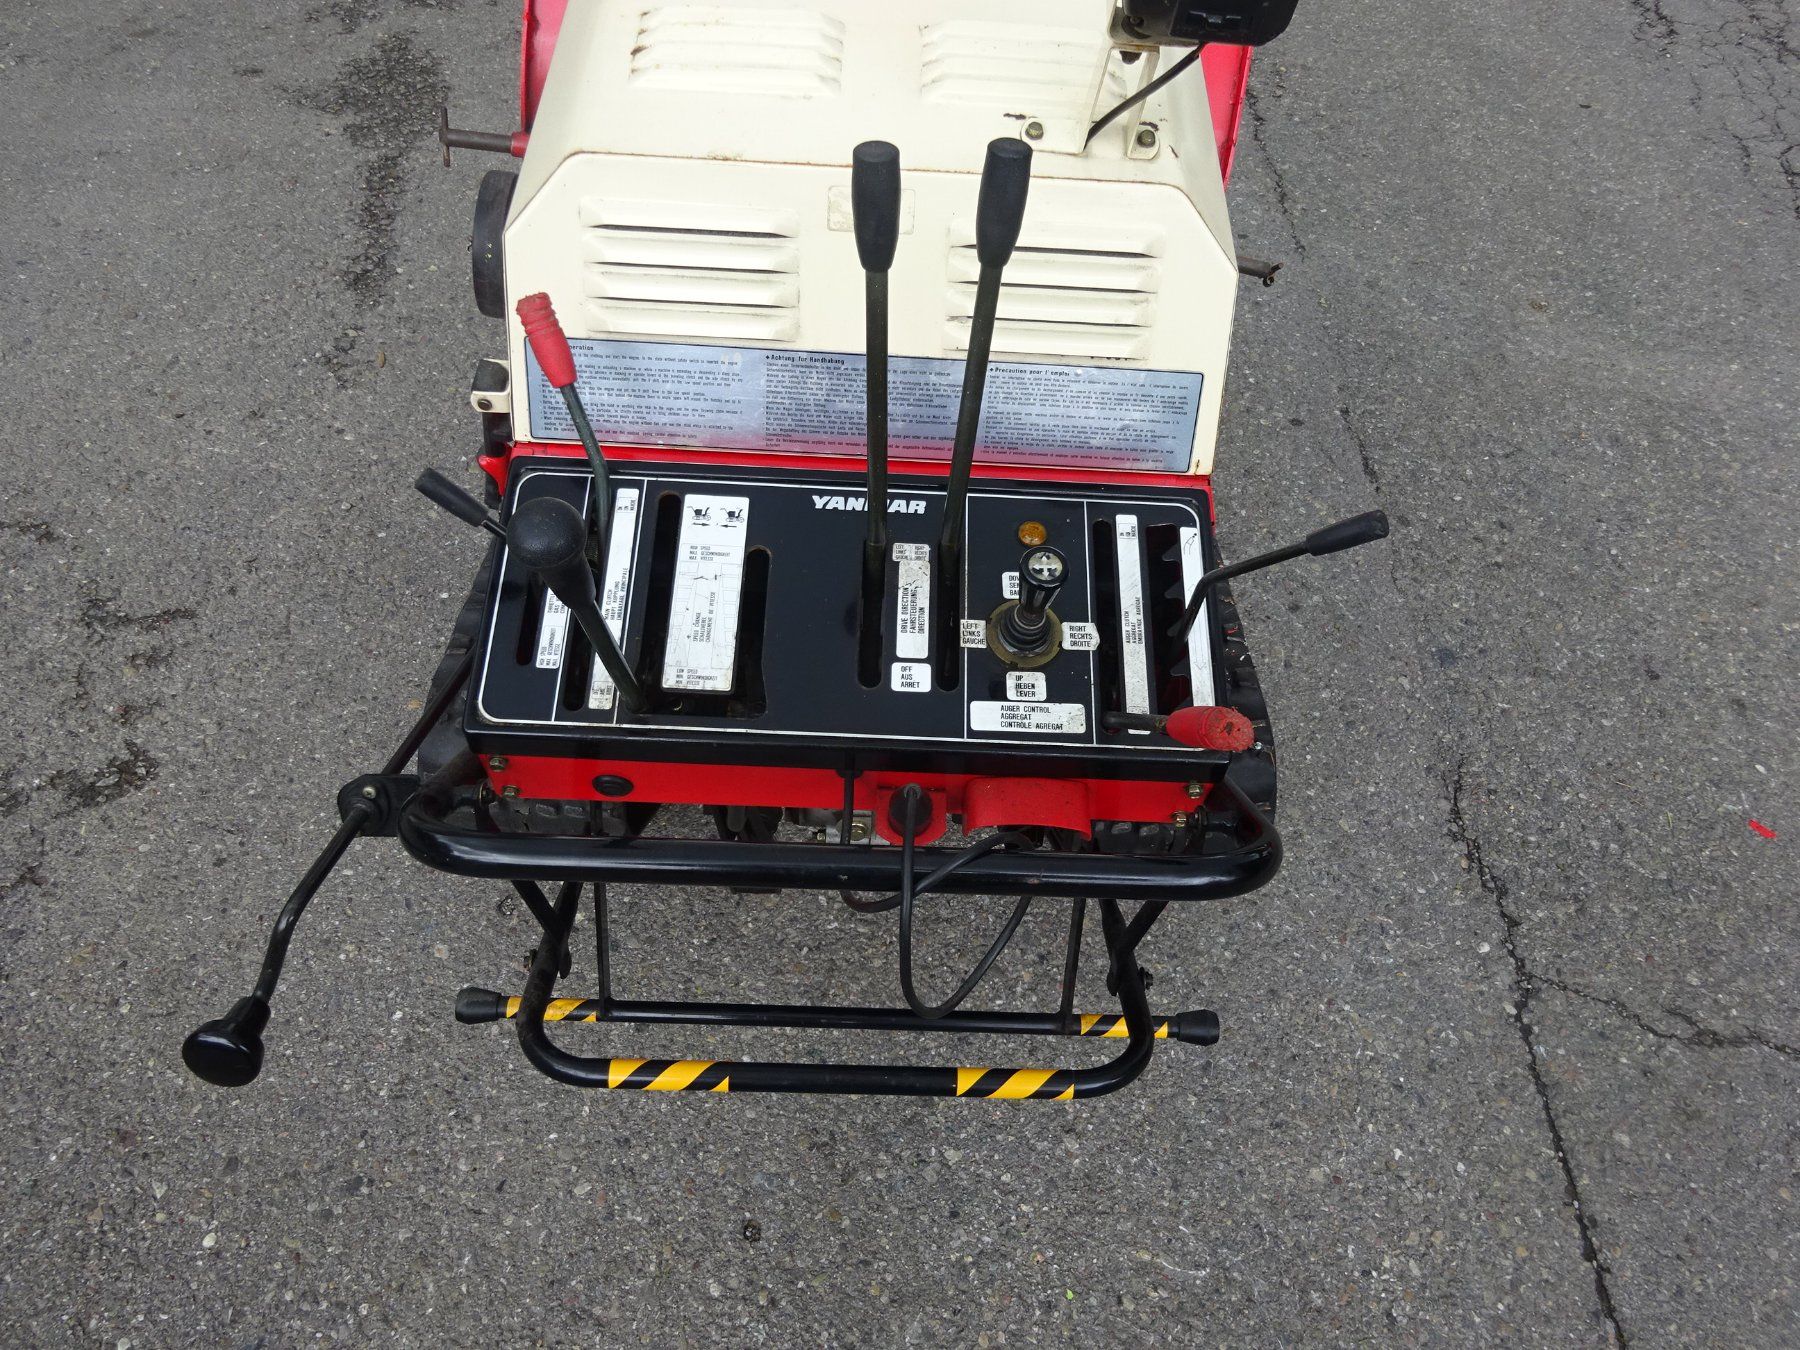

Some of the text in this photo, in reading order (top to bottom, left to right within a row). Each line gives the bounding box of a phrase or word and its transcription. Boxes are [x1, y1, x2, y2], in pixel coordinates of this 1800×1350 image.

[809, 356, 845, 365] Handhabung
[811, 495, 927, 514] YANAR
[909, 588, 918, 634] FAHRSTEUERUNG
[918, 606, 926, 634] DIRECTION
[962, 622, 978, 630] LEFT
[1015, 682, 1036, 690] HEBEN
[1023, 705, 1051, 714] CONTROL
[1035, 722, 1064, 730] AGREGAT
